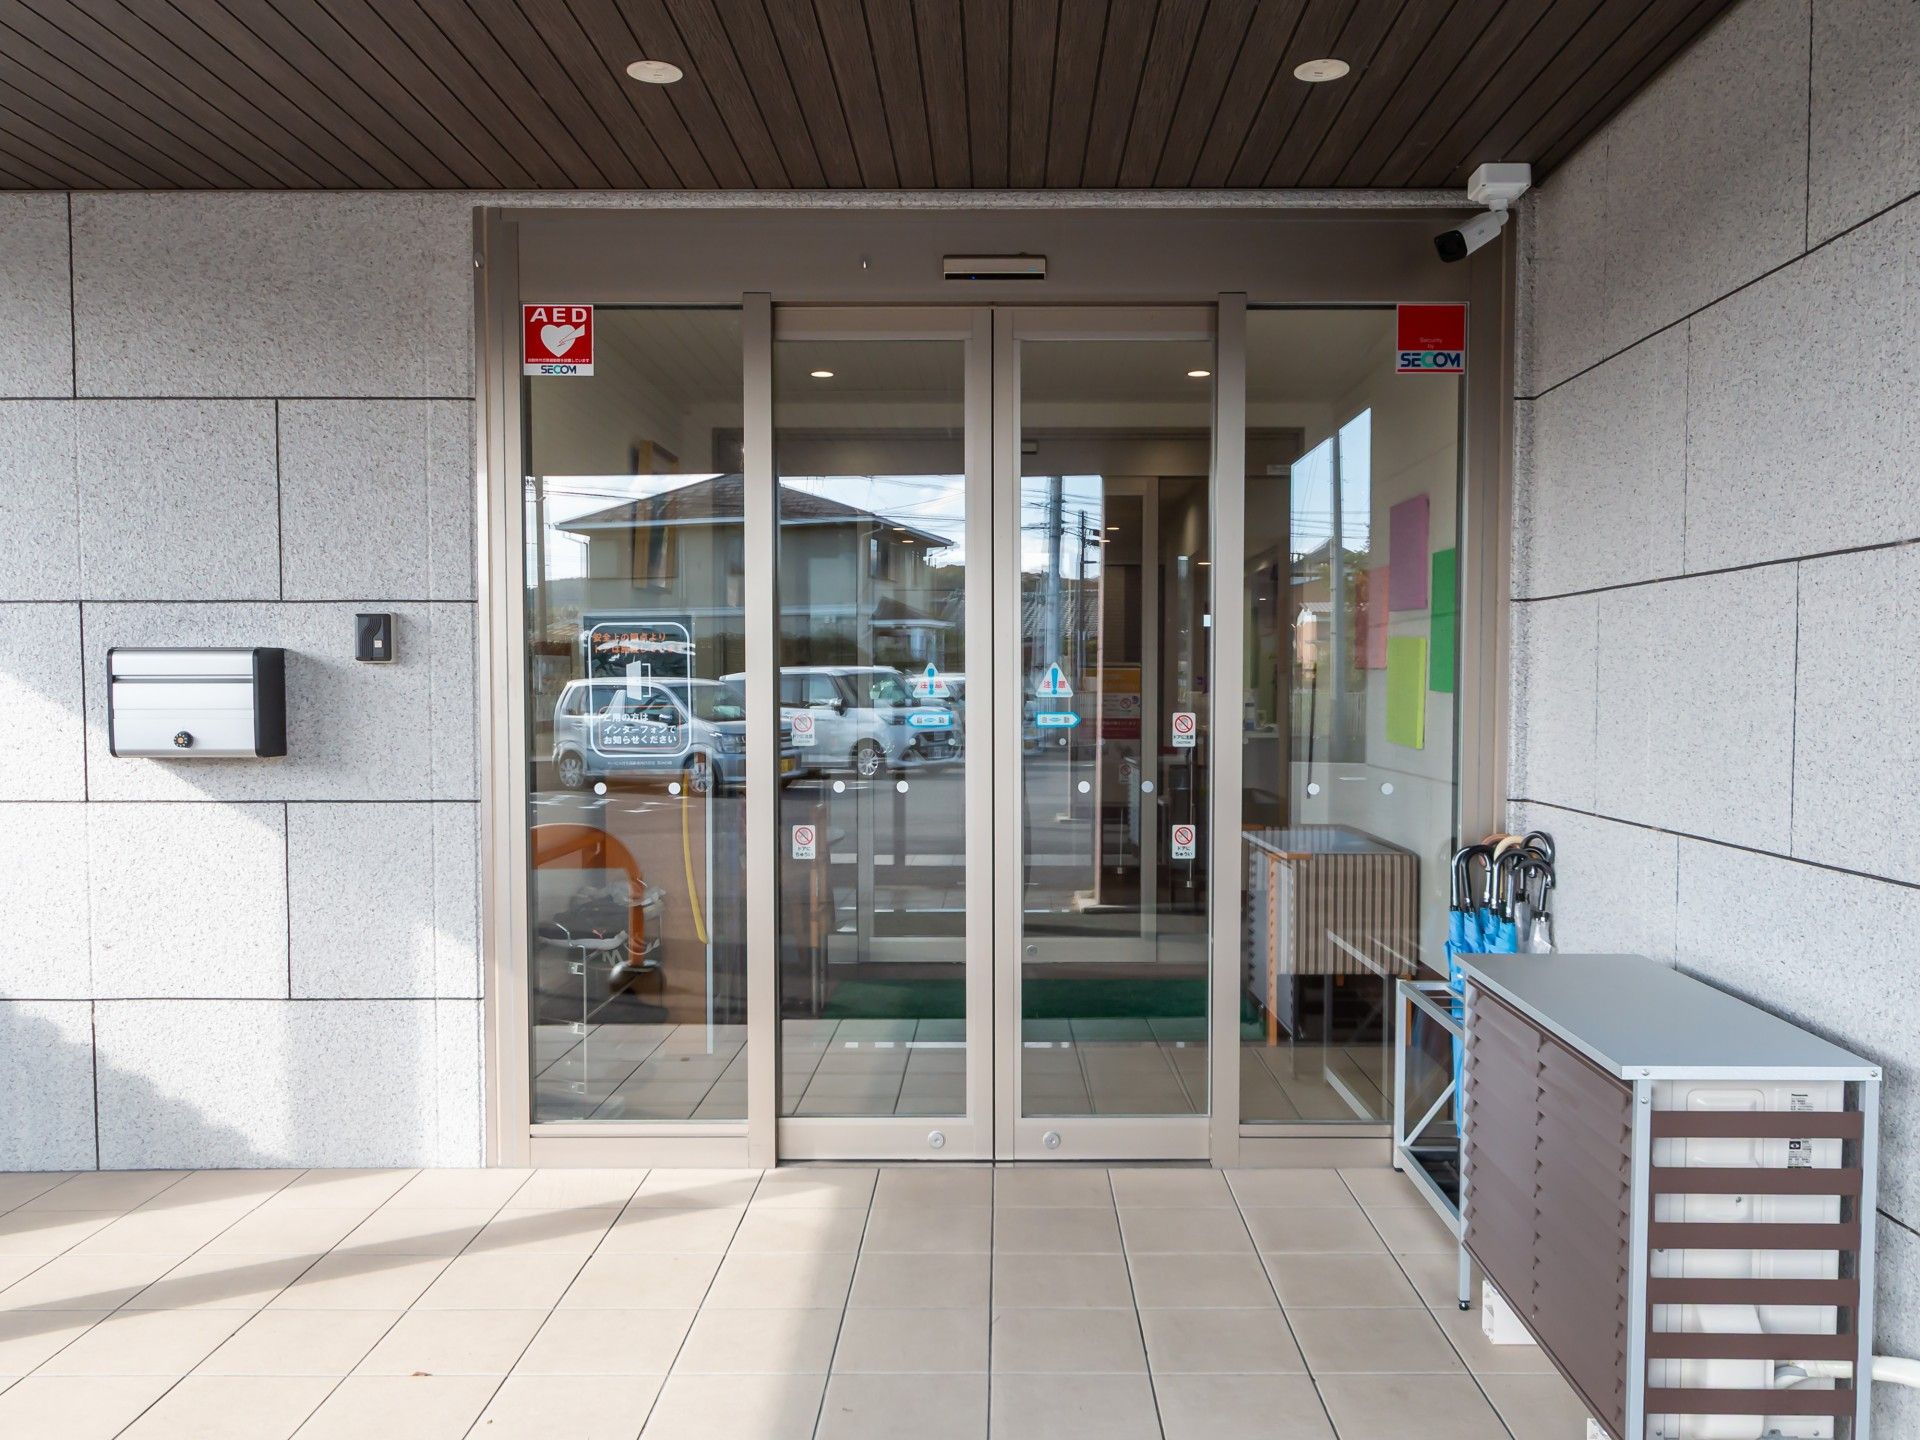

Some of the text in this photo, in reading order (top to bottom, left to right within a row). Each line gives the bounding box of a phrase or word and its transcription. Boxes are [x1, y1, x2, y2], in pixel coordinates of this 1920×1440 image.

[530, 308, 587, 322] AED
[1400, 352, 1461, 368] SECOM
[541, 365, 577, 374] SECOM
[604, 725, 676, 734] インターフォンで
[603, 735, 677, 744] お知らせください
